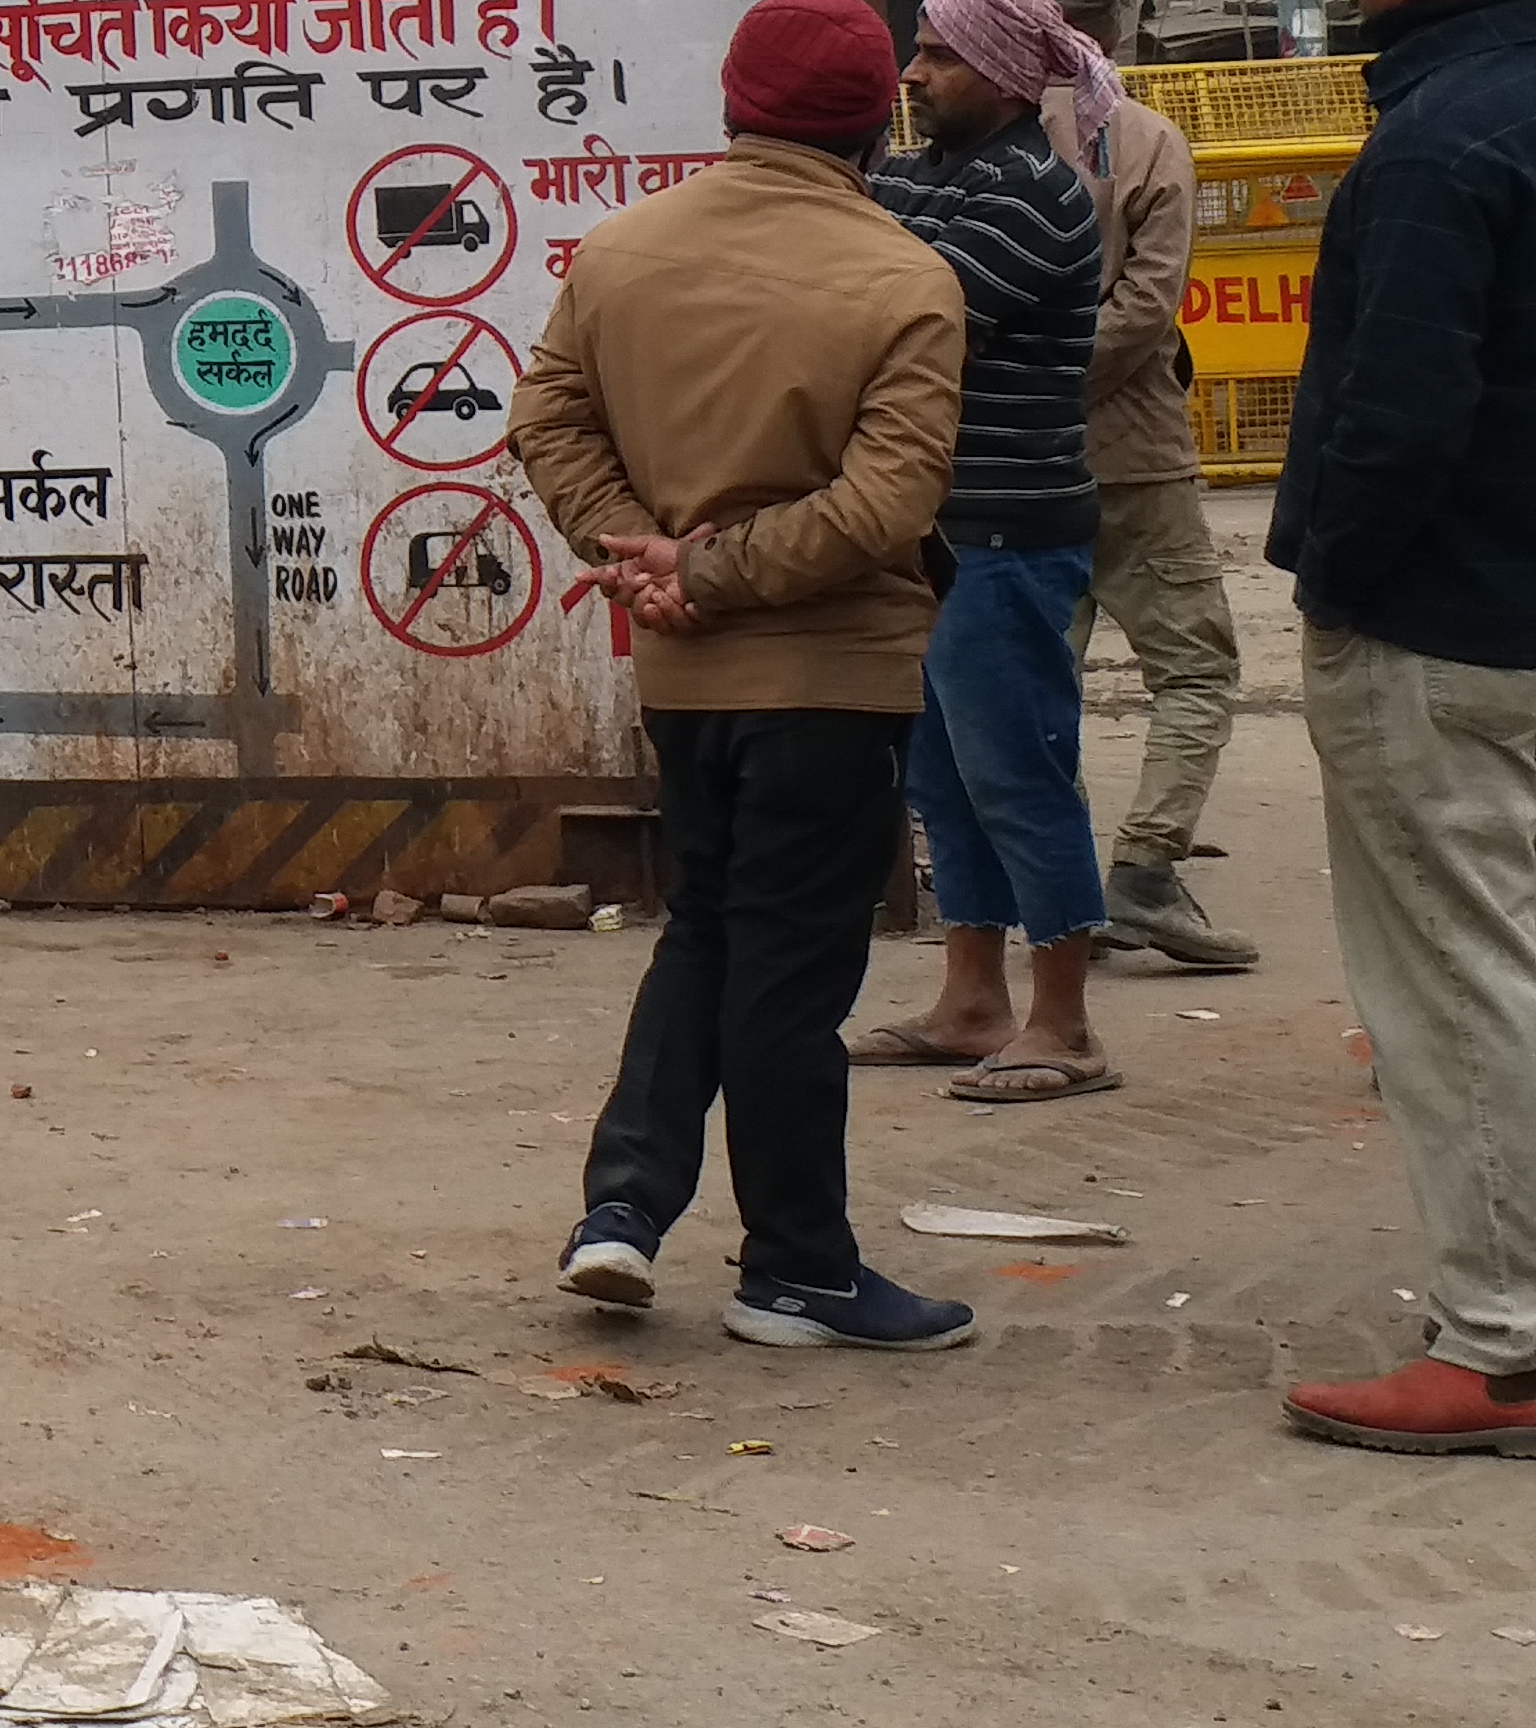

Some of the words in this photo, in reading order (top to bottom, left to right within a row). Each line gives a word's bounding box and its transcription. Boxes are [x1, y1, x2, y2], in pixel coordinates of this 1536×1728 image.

[358, 68, 488, 117] पर
[522, 133, 632, 209] भारी
[635, 152, 728, 196] वा
[187, 309, 274, 353] हमदर्द
[194, 350, 275, 389] सर्कल
[272, 491, 321, 520] ONE
[272, 525, 326, 559] WAY
[275, 564, 338, 604] ROAD
